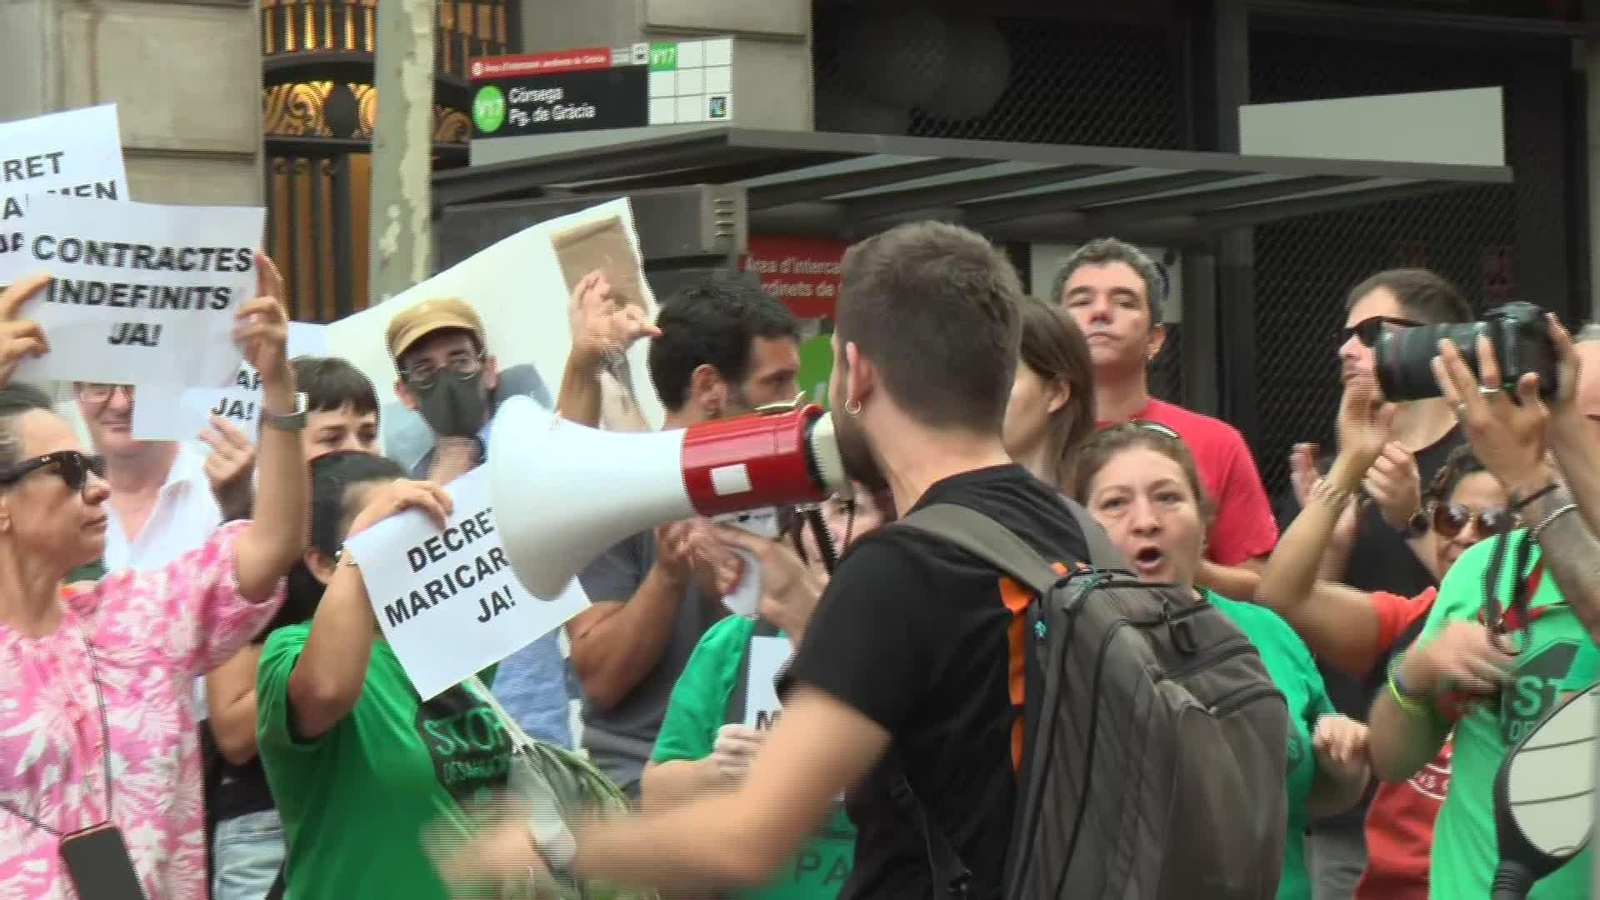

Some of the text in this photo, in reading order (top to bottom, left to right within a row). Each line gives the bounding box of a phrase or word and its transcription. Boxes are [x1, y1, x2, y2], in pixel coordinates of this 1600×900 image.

[533, 107, 550, 122] de
[551, 102, 596, 121] Gràcia
[31, 234, 254, 273] CONTRACTES
[46, 276, 233, 311] INDEFINITS
[815, 280, 835, 298] de
[107, 322, 163, 348] JA!
[210, 396, 255, 420] JA!
[406, 506, 495, 574] DECRE
[476, 584, 517, 624] JA!
